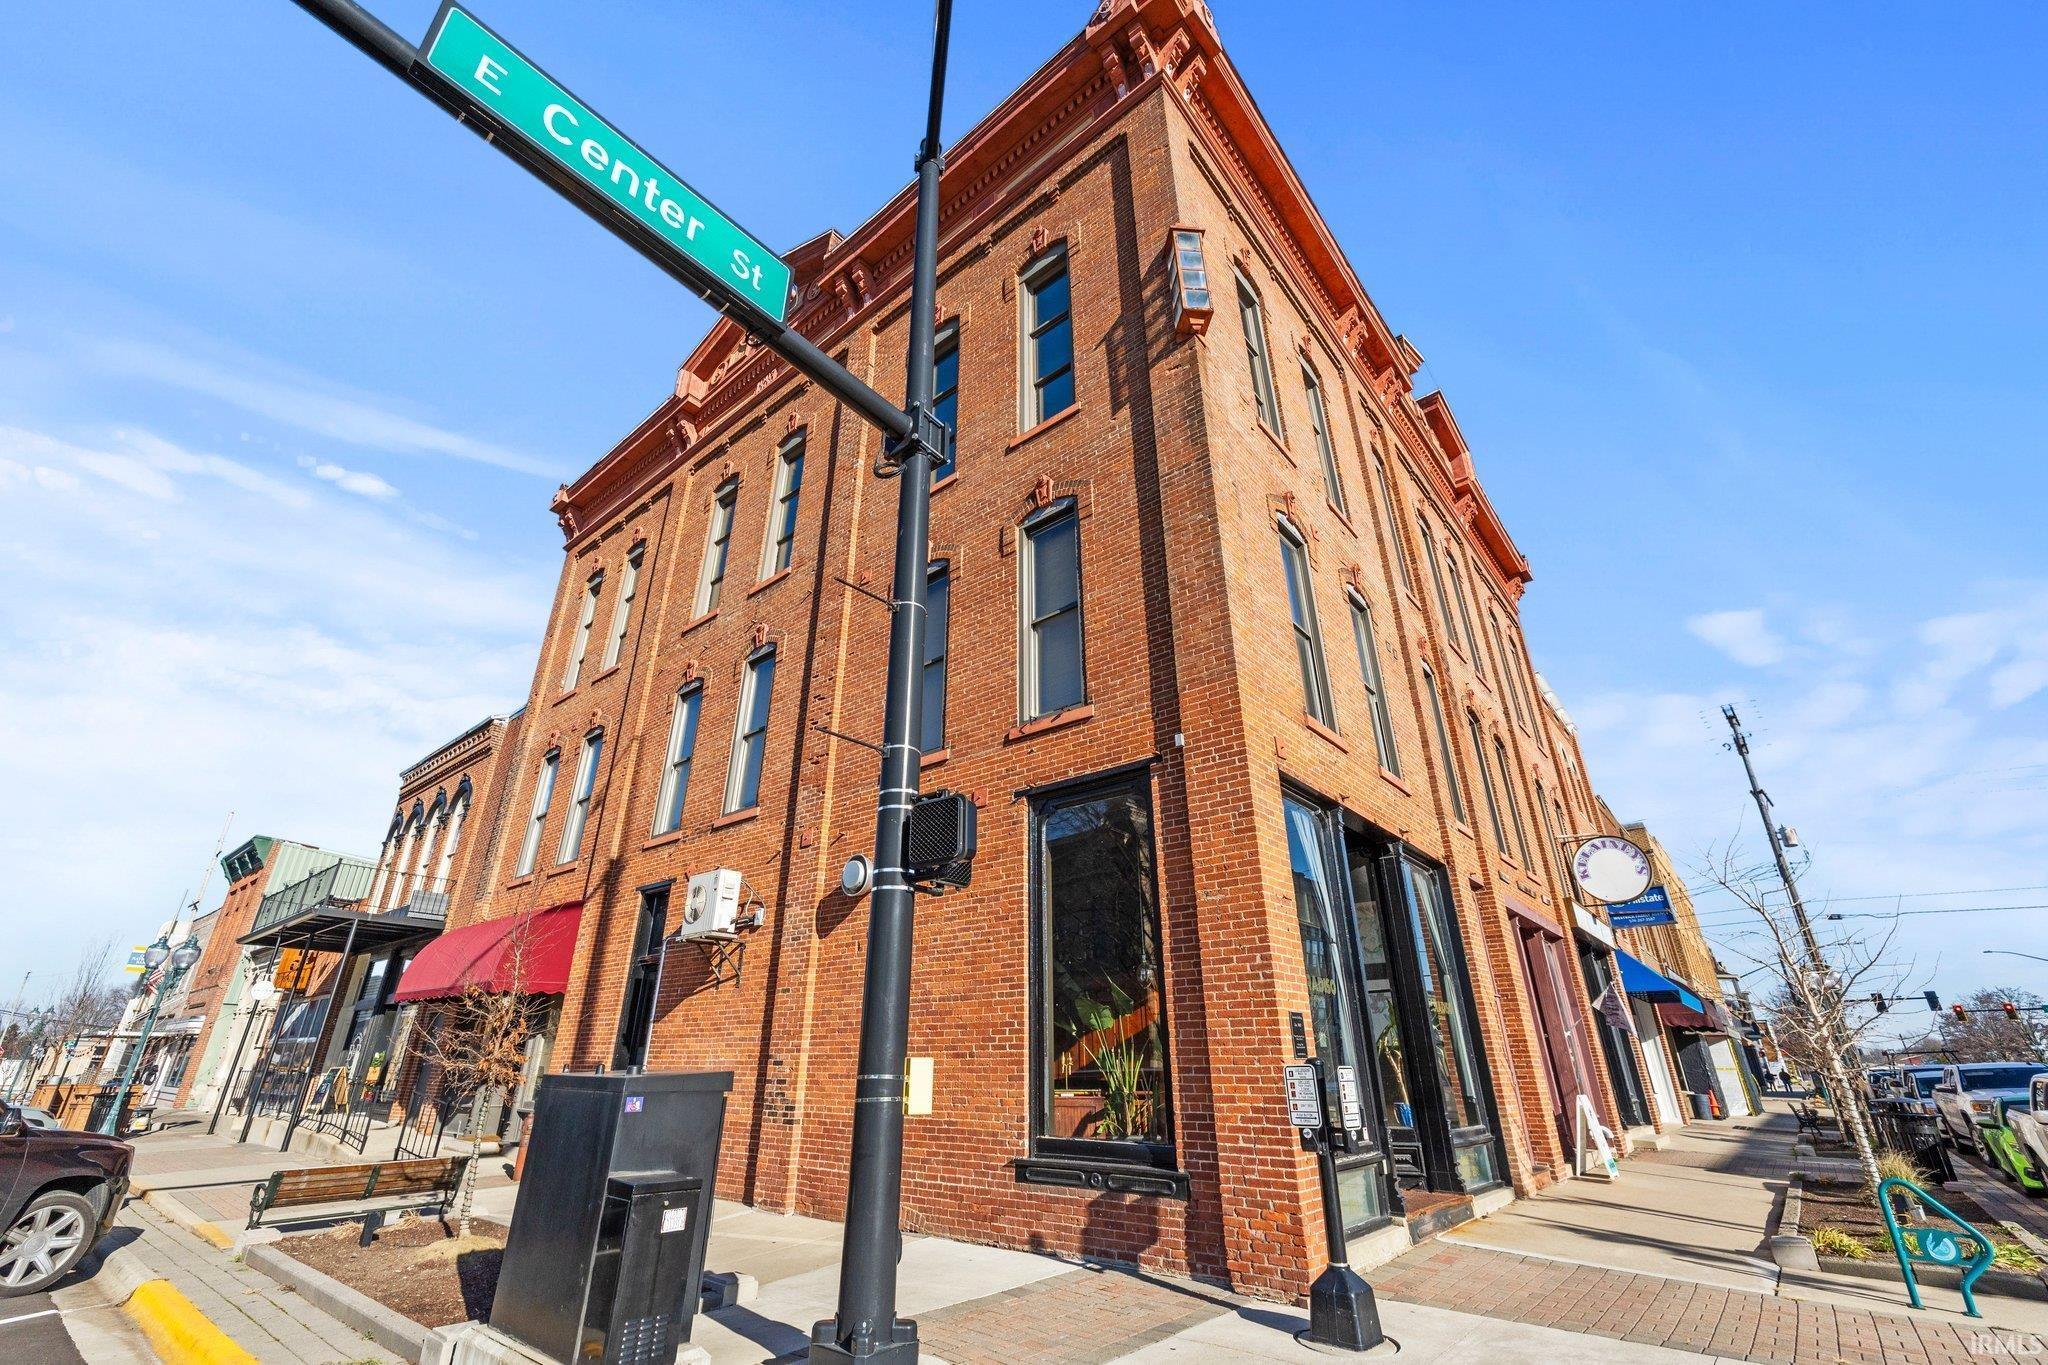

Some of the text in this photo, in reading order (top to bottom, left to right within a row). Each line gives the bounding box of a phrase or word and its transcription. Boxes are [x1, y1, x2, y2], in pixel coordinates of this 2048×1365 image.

[473, 54, 764, 292] E Center St
[1628, 893, 1665, 904] lstate
